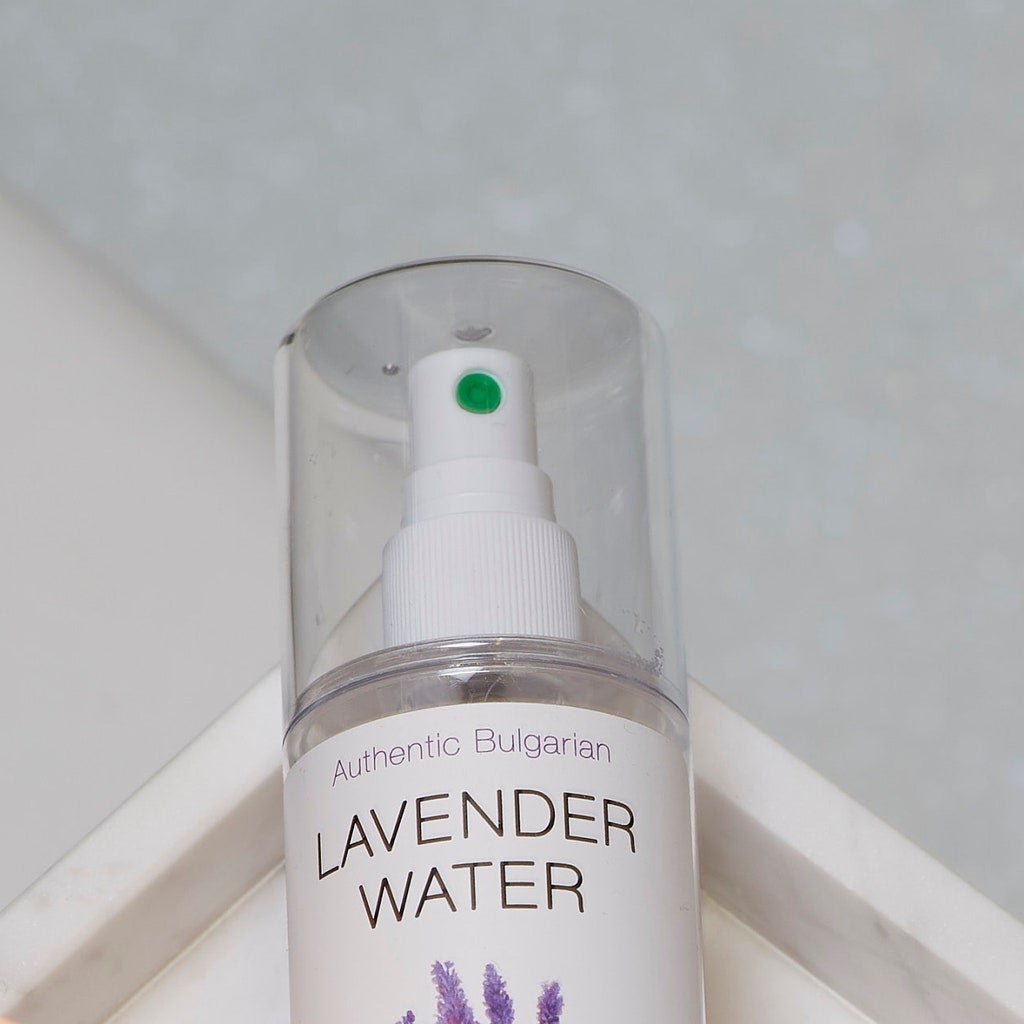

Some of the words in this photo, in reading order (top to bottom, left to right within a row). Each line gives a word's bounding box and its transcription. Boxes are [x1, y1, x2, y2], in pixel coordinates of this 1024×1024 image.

[332, 732, 461, 787] Authentic
[475, 728, 612, 763] Bulgarian
[317, 789, 636, 880] LAVENDER
[358, 861, 585, 929] WATER
